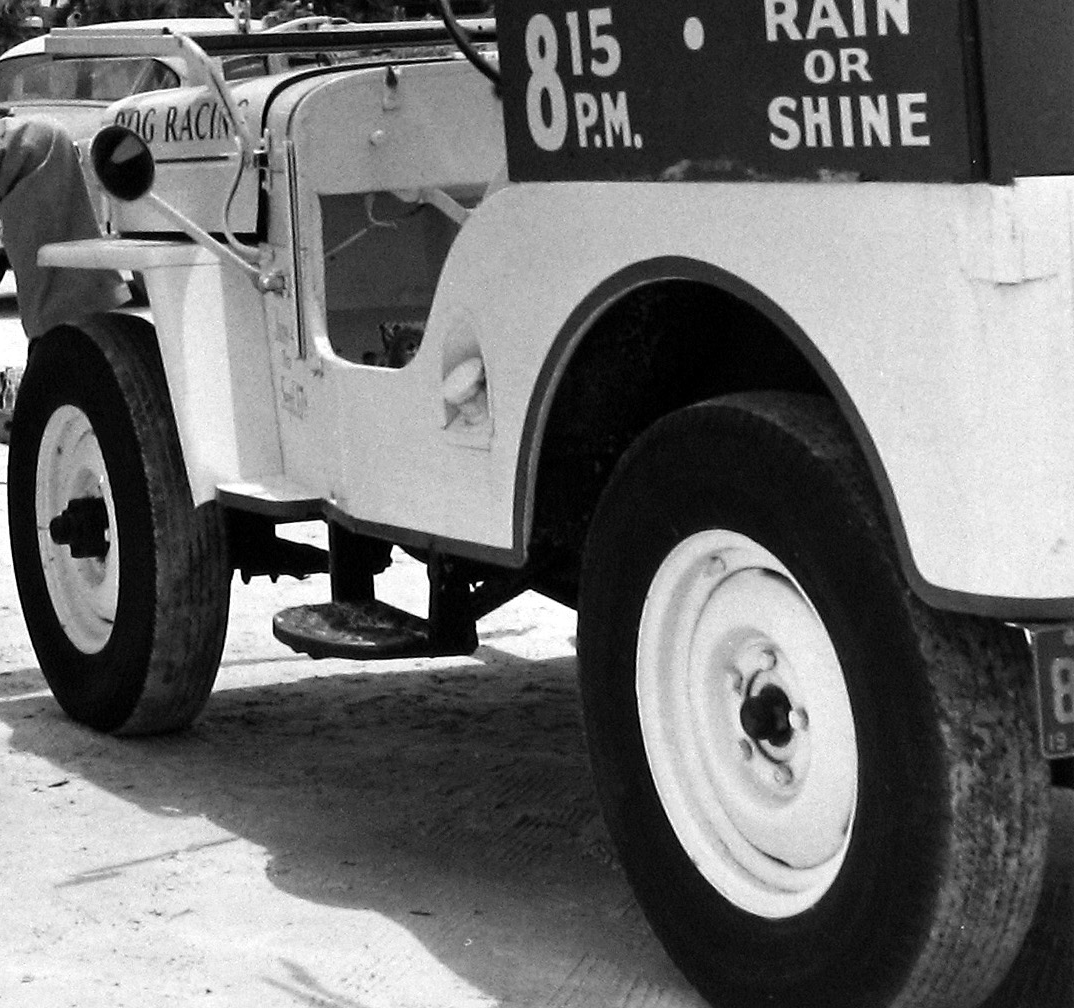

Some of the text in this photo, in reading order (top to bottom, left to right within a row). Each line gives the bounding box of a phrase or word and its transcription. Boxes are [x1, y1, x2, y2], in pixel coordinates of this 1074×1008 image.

[803, 47, 873, 85] OR
[575, 91, 643, 149] P.M.
[767, 92, 931, 151] SHINE
